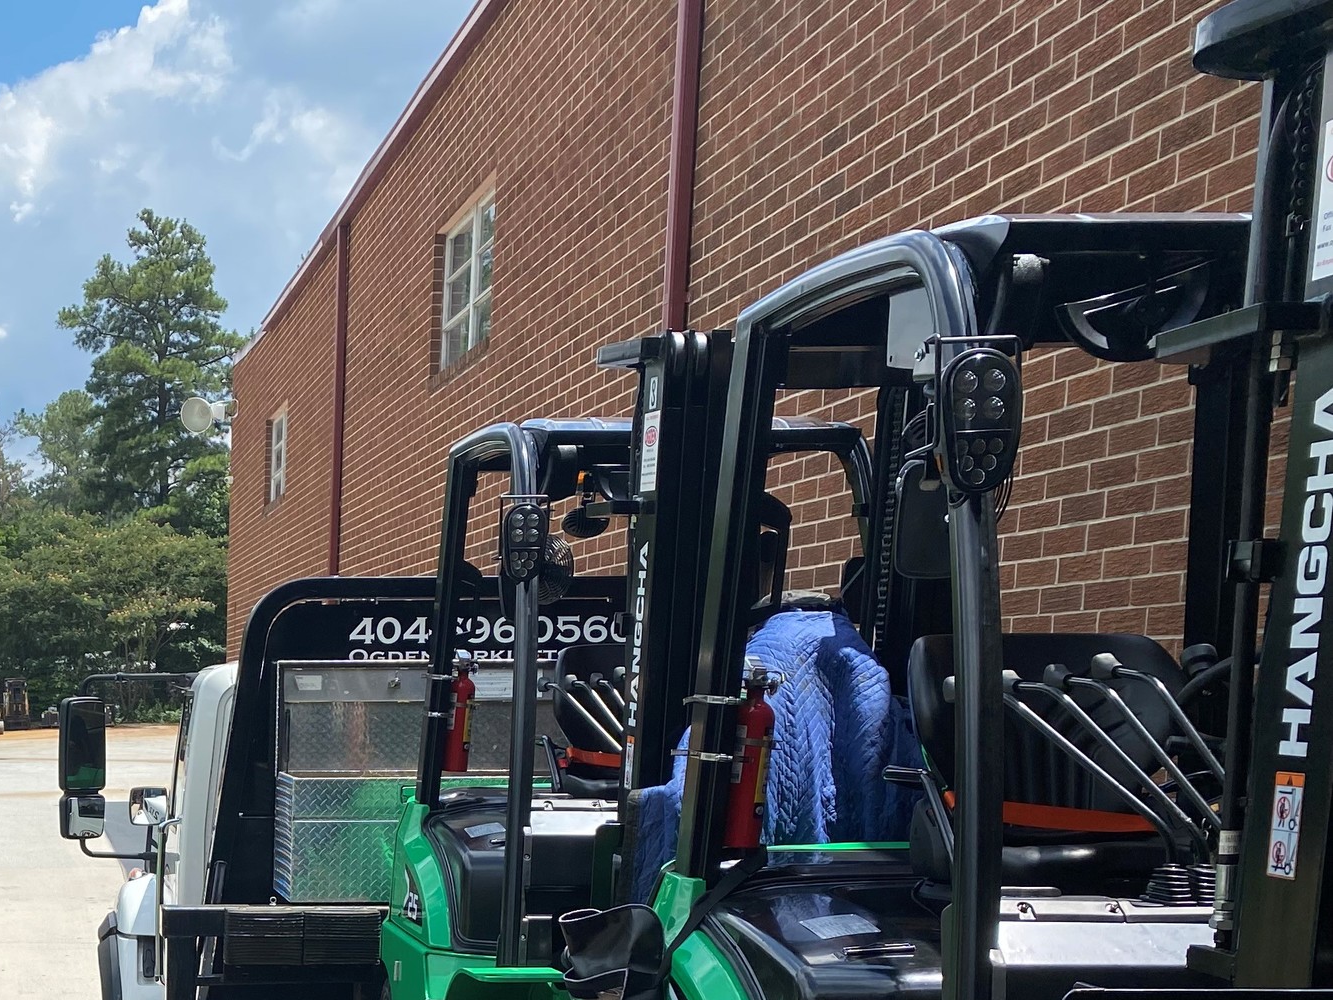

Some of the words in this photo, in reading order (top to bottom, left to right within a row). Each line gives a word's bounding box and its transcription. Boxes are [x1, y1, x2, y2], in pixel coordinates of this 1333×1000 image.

[628, 541, 649, 727] HANGCHA
[1278, 387, 1333, 759] HANGCHA
[408, 891, 418, 920] 25
